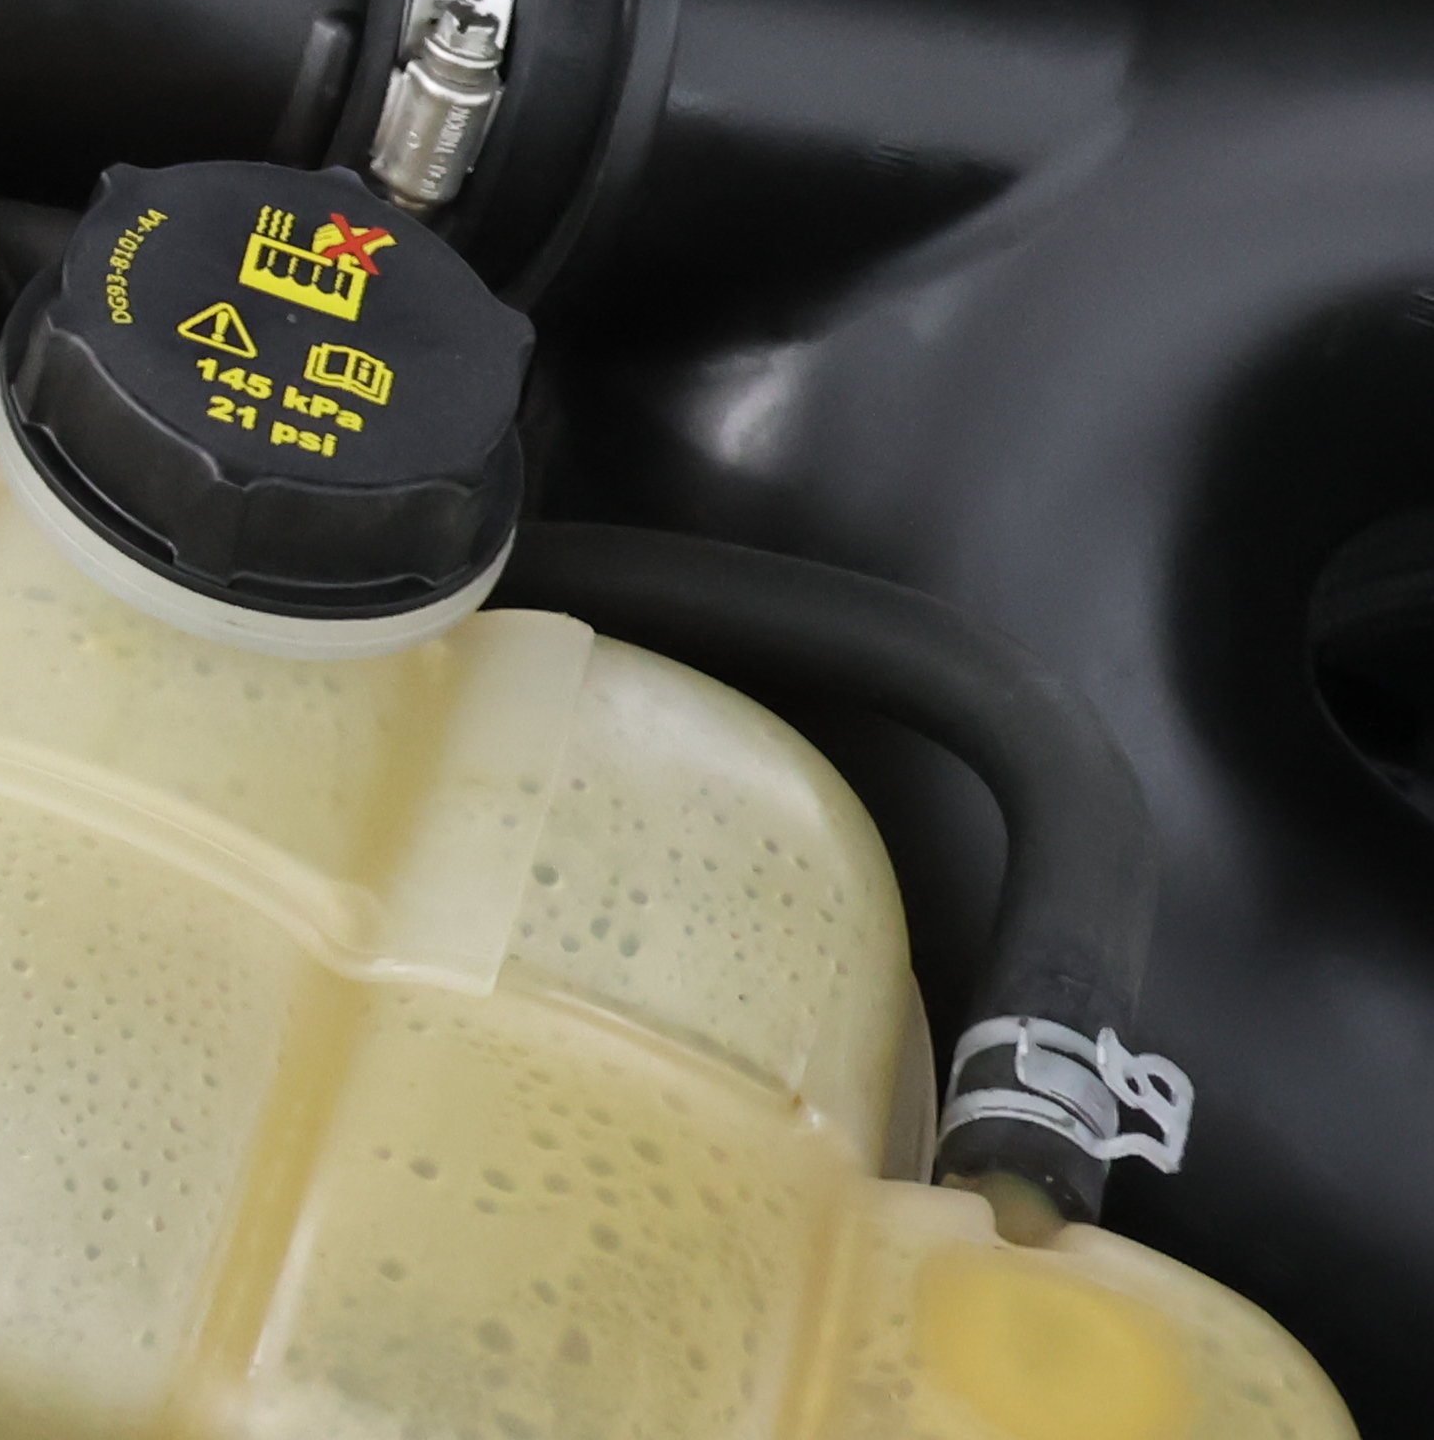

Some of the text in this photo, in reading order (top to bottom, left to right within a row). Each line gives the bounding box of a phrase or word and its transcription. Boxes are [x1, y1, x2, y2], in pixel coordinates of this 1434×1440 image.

[105, 207, 169, 325] DG93-8101-AA
[195, 356, 365, 433] 145 kPa
[205, 394, 339, 458] 21 psi
